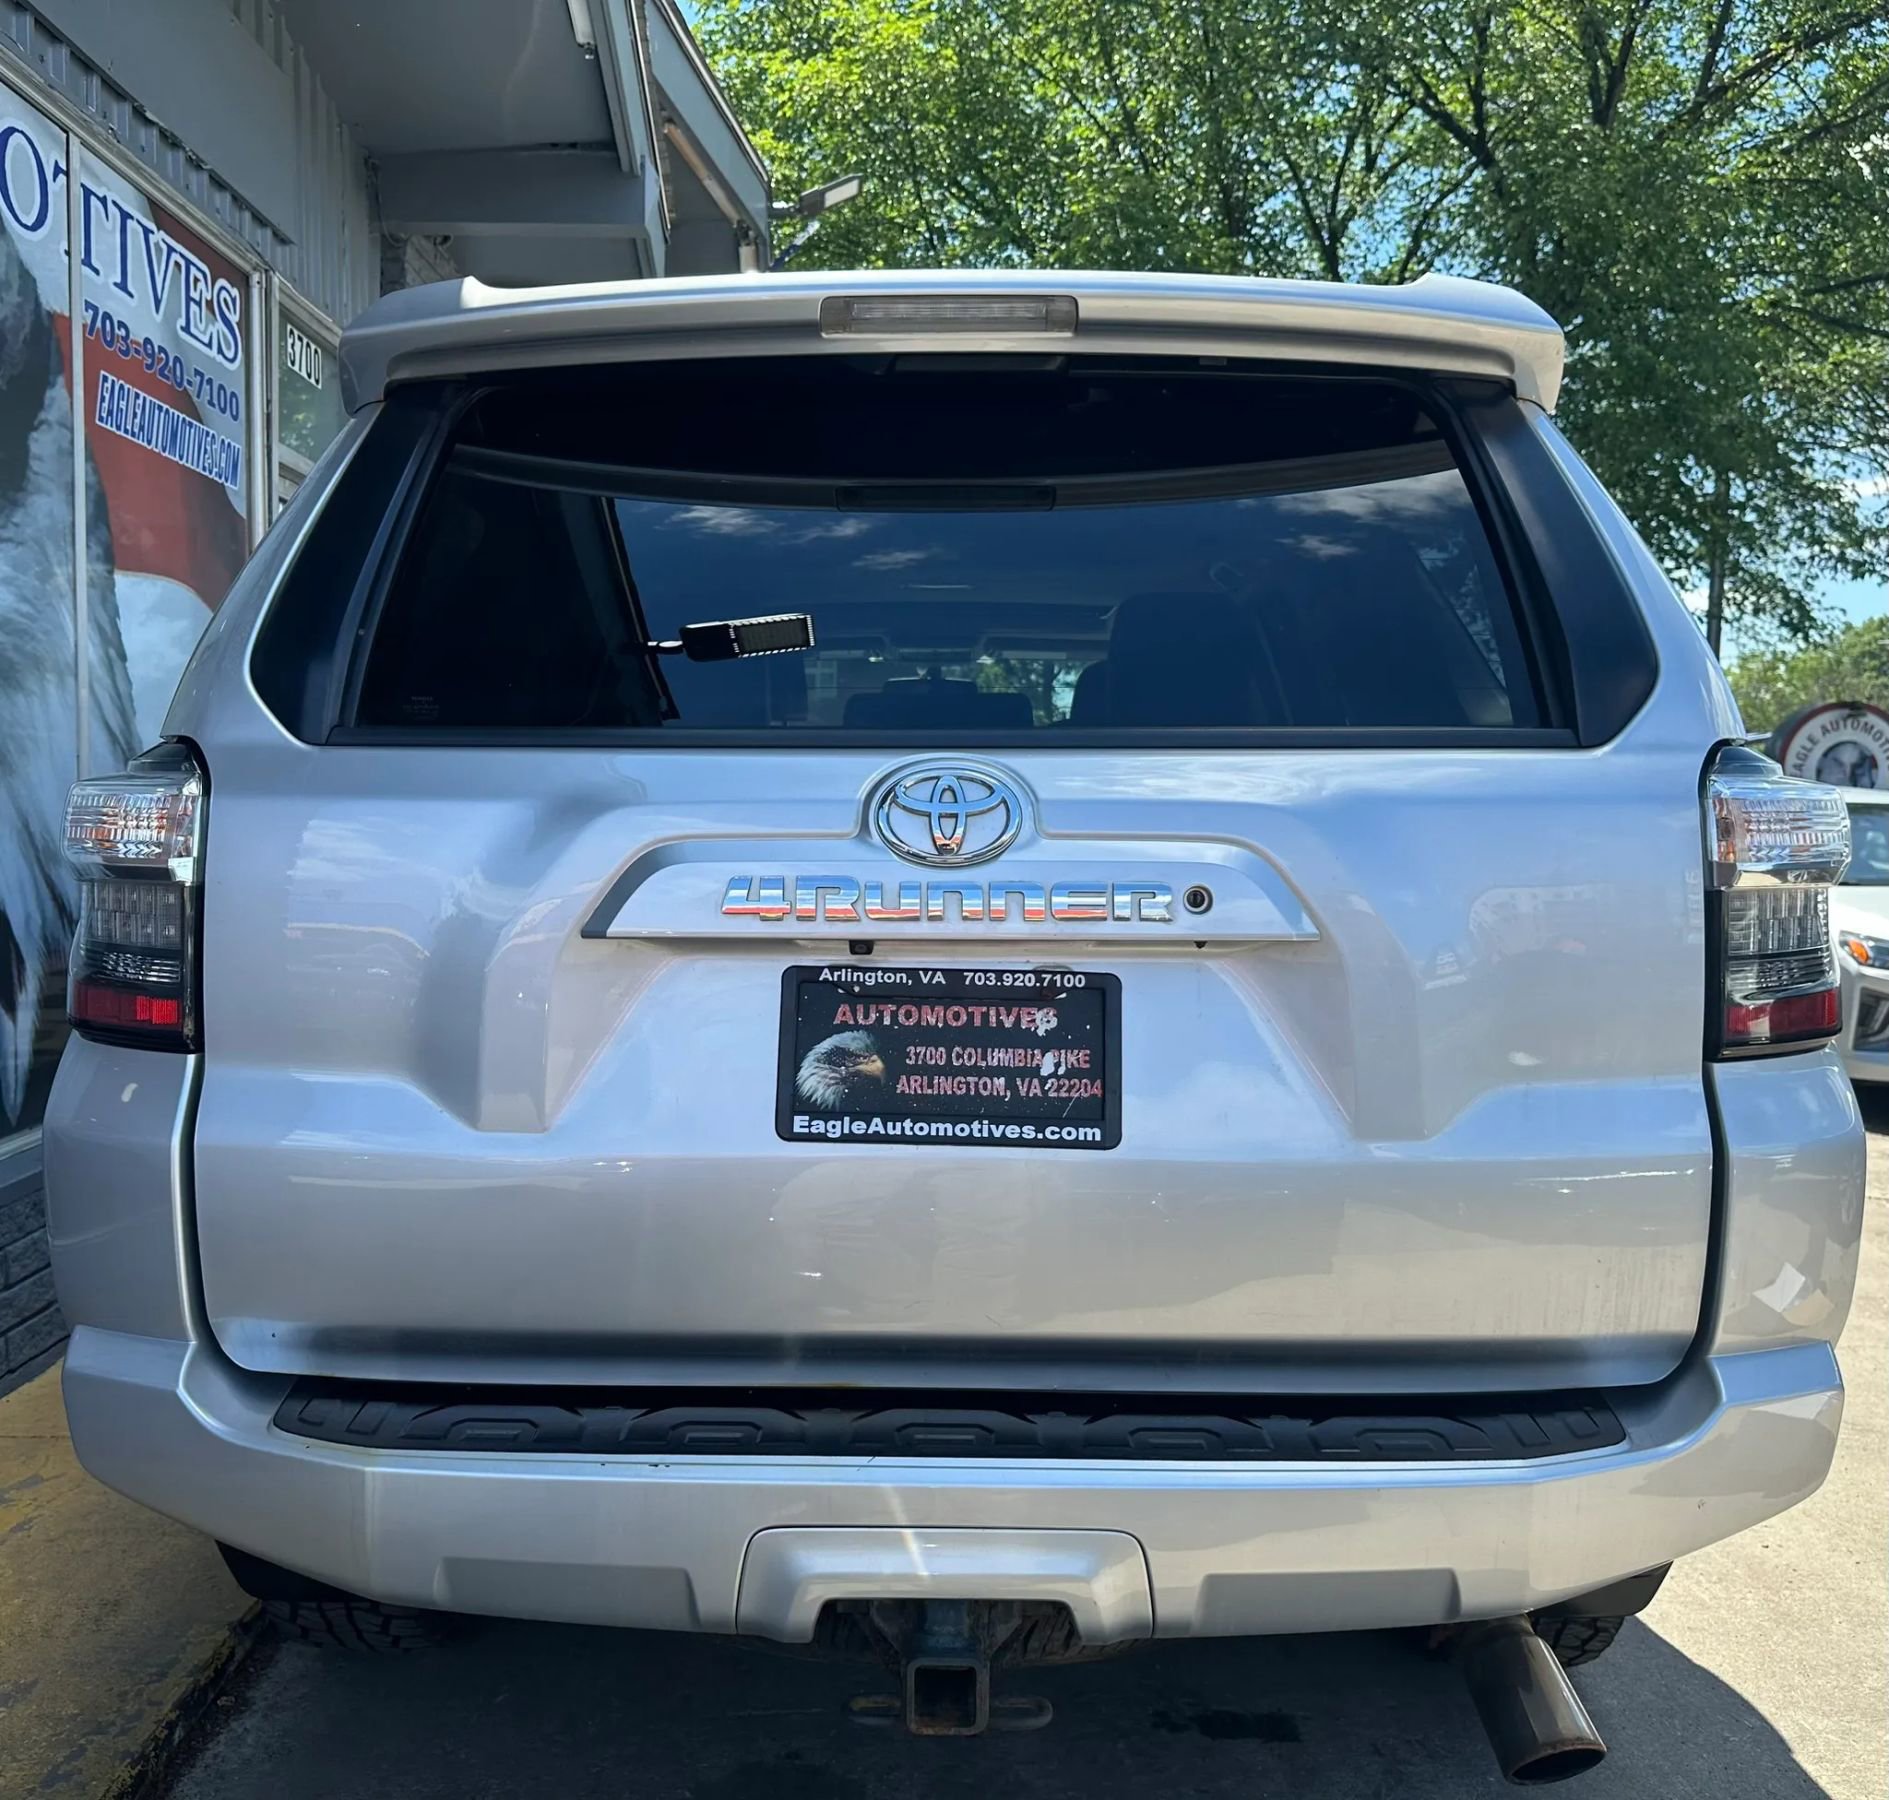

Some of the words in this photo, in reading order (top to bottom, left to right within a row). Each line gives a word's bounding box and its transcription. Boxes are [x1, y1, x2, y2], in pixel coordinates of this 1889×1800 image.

[84, 299, 240, 422] 703-920-7100
[288, 324, 321, 387] 3700
[98, 372, 241, 488] EAGLEAUTOMOTIVES.COM
[818, 967, 913, 986] Arlington,
[919, 970, 946, 985] VA
[963, 972, 1086, 988] 703.920.7100
[833, 1003, 1058, 1031] AUTOMOTIVES
[905, 1046, 946, 1066] 3700
[952, 1047, 1042, 1068] COLUMBIA
[896, 1075, 1012, 1099] ARLINGTON,
[1017, 1078, 1042, 1097] VA
[1047, 1078, 1103, 1098] 22204
[792, 1115, 1102, 1142] EagleAutomotives.com
